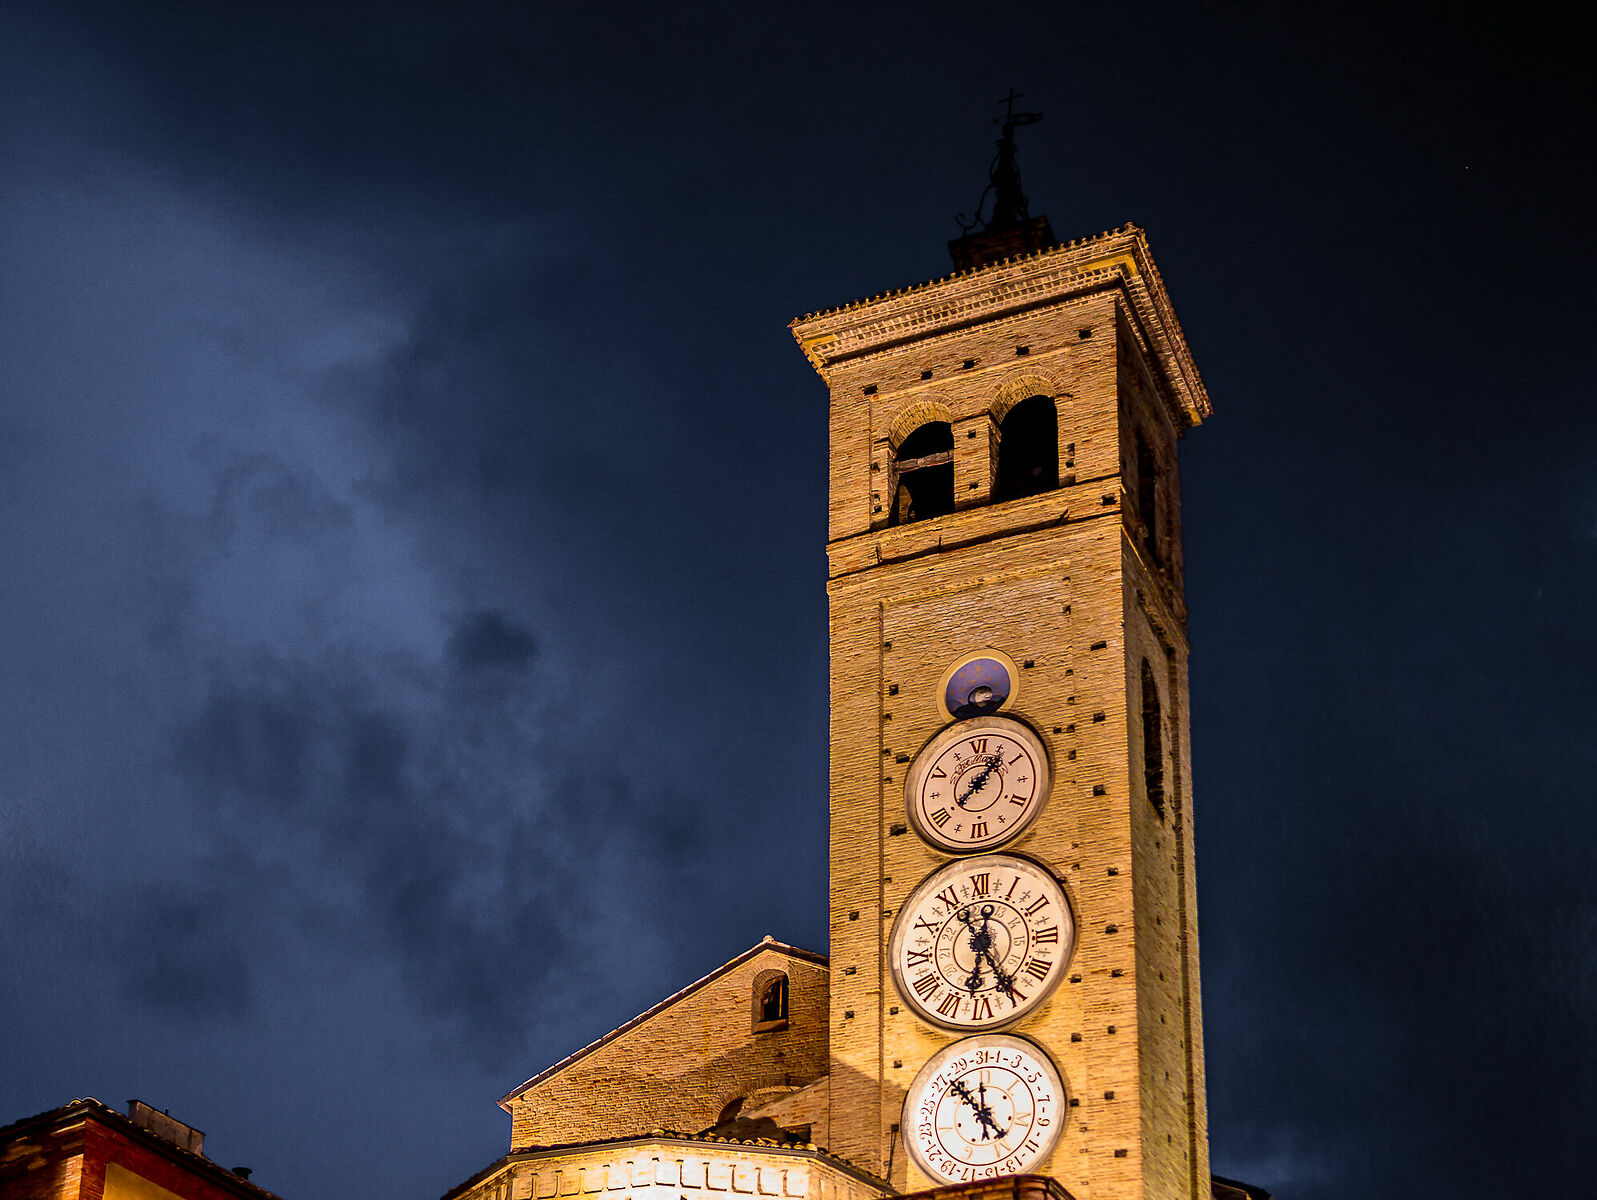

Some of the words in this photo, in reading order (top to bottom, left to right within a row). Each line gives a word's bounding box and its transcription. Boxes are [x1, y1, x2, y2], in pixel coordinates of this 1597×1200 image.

[969, 738, 988, 754] VI
[931, 766, 947, 779] V
[1009, 793, 1027, 807] II
[930, 807, 952, 828] IIII
[970, 822, 989, 839] III
[969, 872, 990, 897] XII
[1005, 876, 1021, 898] I
[935, 884, 960, 912] XI
[1025, 893, 1050, 916] II
[913, 915, 939, 935] X
[1035, 925, 1058, 944] III
[907, 948, 930, 968] IX
[1026, 957, 1053, 983] IIII
[912, 972, 940, 1002] VIII
[936, 993, 962, 1019] VII
[971, 997, 995, 1021] VI
[976, 1050, 989, 1064] 31
[1010, 1054, 1023, 1068] 3
[951, 1058, 968, 1075] 29
[931, 1074, 948, 1093] 27
[1027, 1071, 1043, 1083] 5
[919, 1099, 936, 1116] 25
[919, 1122, 933, 1138] 23
[925, 1143, 942, 1162] 21
[1025, 1139, 1040, 1154] 11
[941, 1159, 957, 1176] 19
[1005, 1155, 1023, 1172] 13
[961, 1168, 976, 1182] 17
